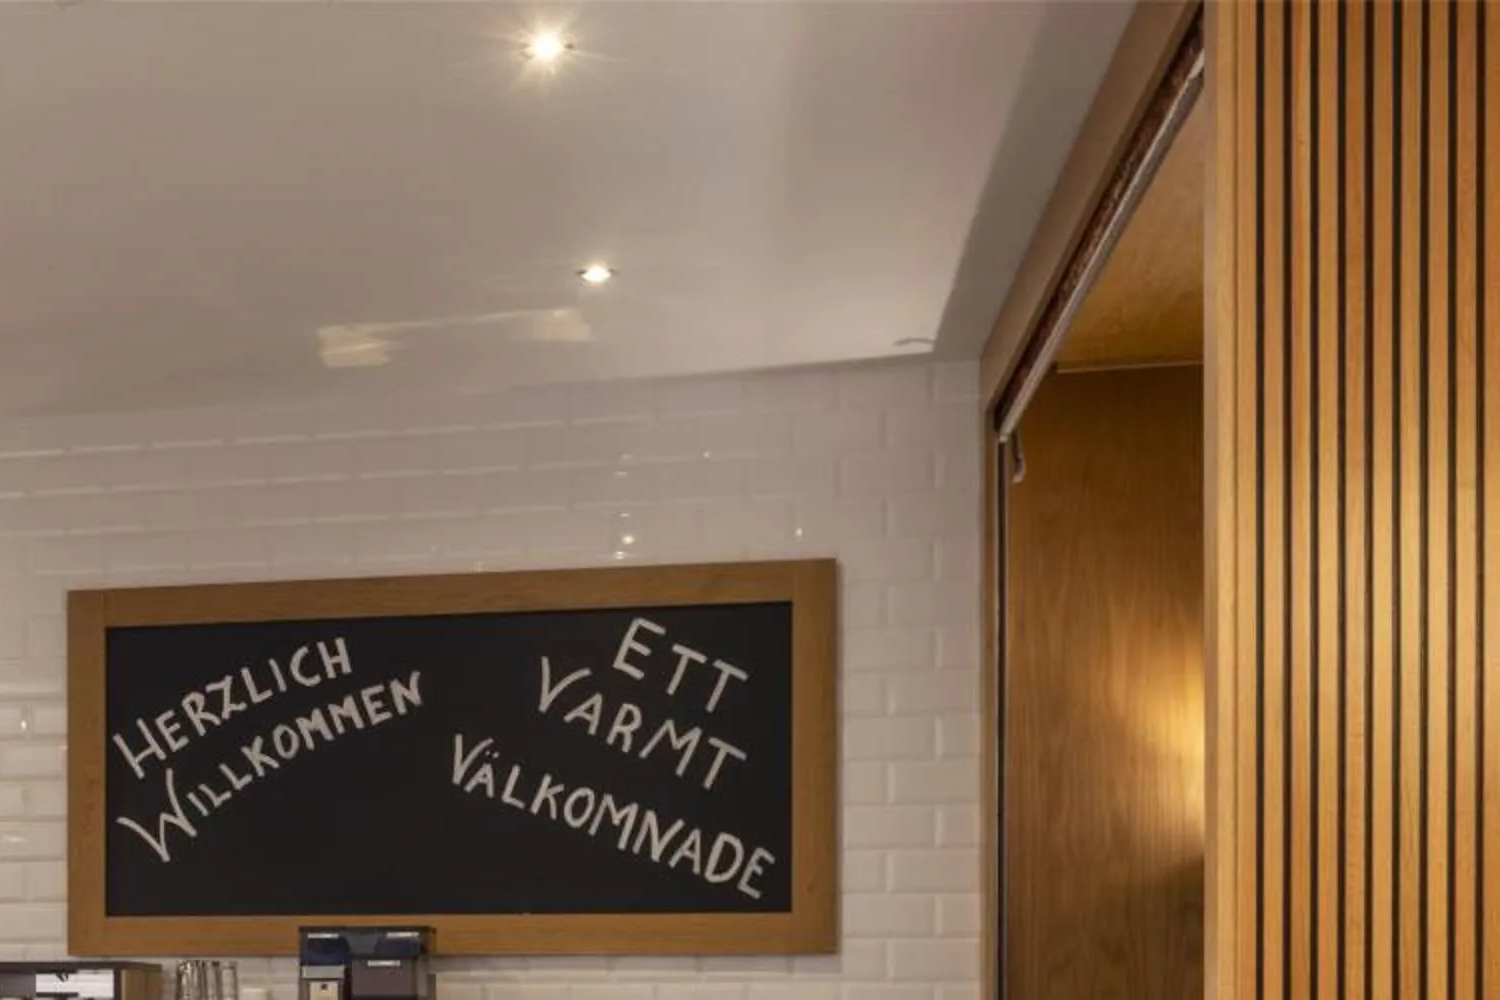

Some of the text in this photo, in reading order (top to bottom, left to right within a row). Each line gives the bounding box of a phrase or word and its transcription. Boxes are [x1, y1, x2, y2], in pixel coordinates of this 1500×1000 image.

[112, 637, 352, 780] HERZLICH
[538, 655, 747, 790] VARMT
[612, 617, 748, 713] ETT
[116, 671, 422, 863] WILLKOMMEN
[452, 733, 775, 899] VÄLKOMNADE
